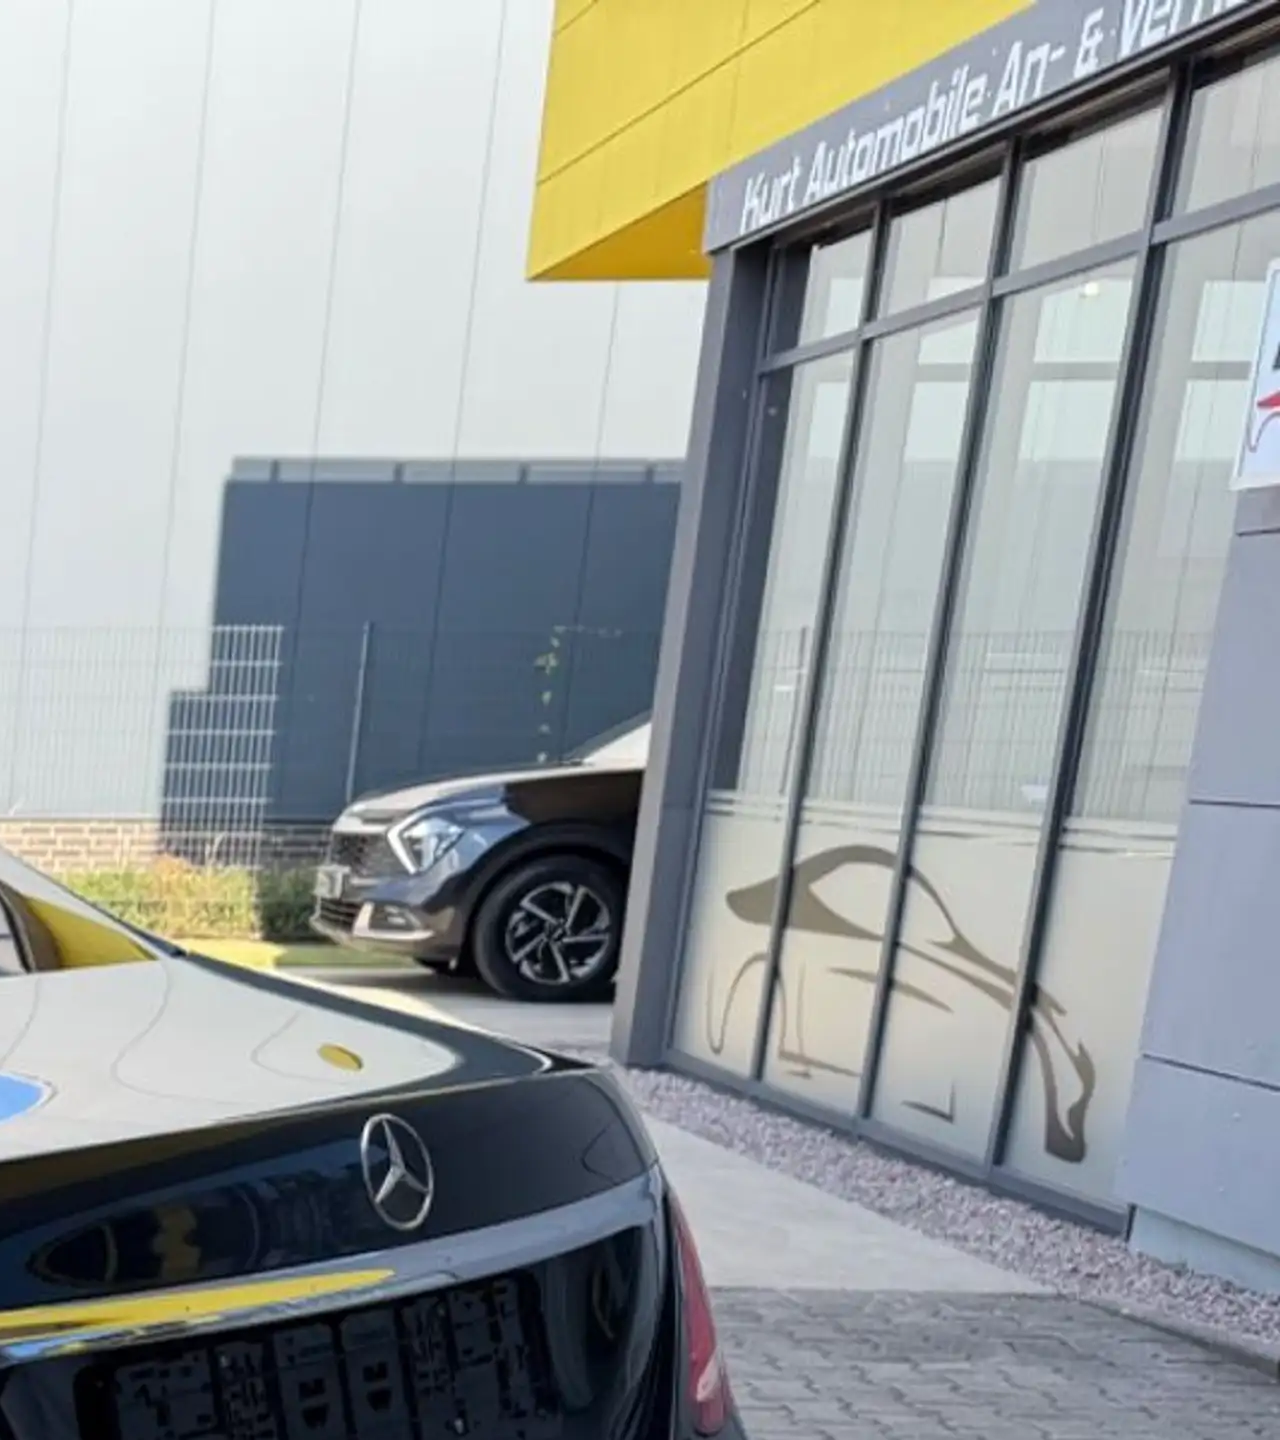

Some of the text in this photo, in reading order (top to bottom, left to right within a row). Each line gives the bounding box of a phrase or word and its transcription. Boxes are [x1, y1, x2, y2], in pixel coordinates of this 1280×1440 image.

[740, 156, 801, 236] Kurt
[802, 64, 988, 207] Automobile
[992, 40, 1066, 117] An-
[1073, 8, 1104, 78] &
